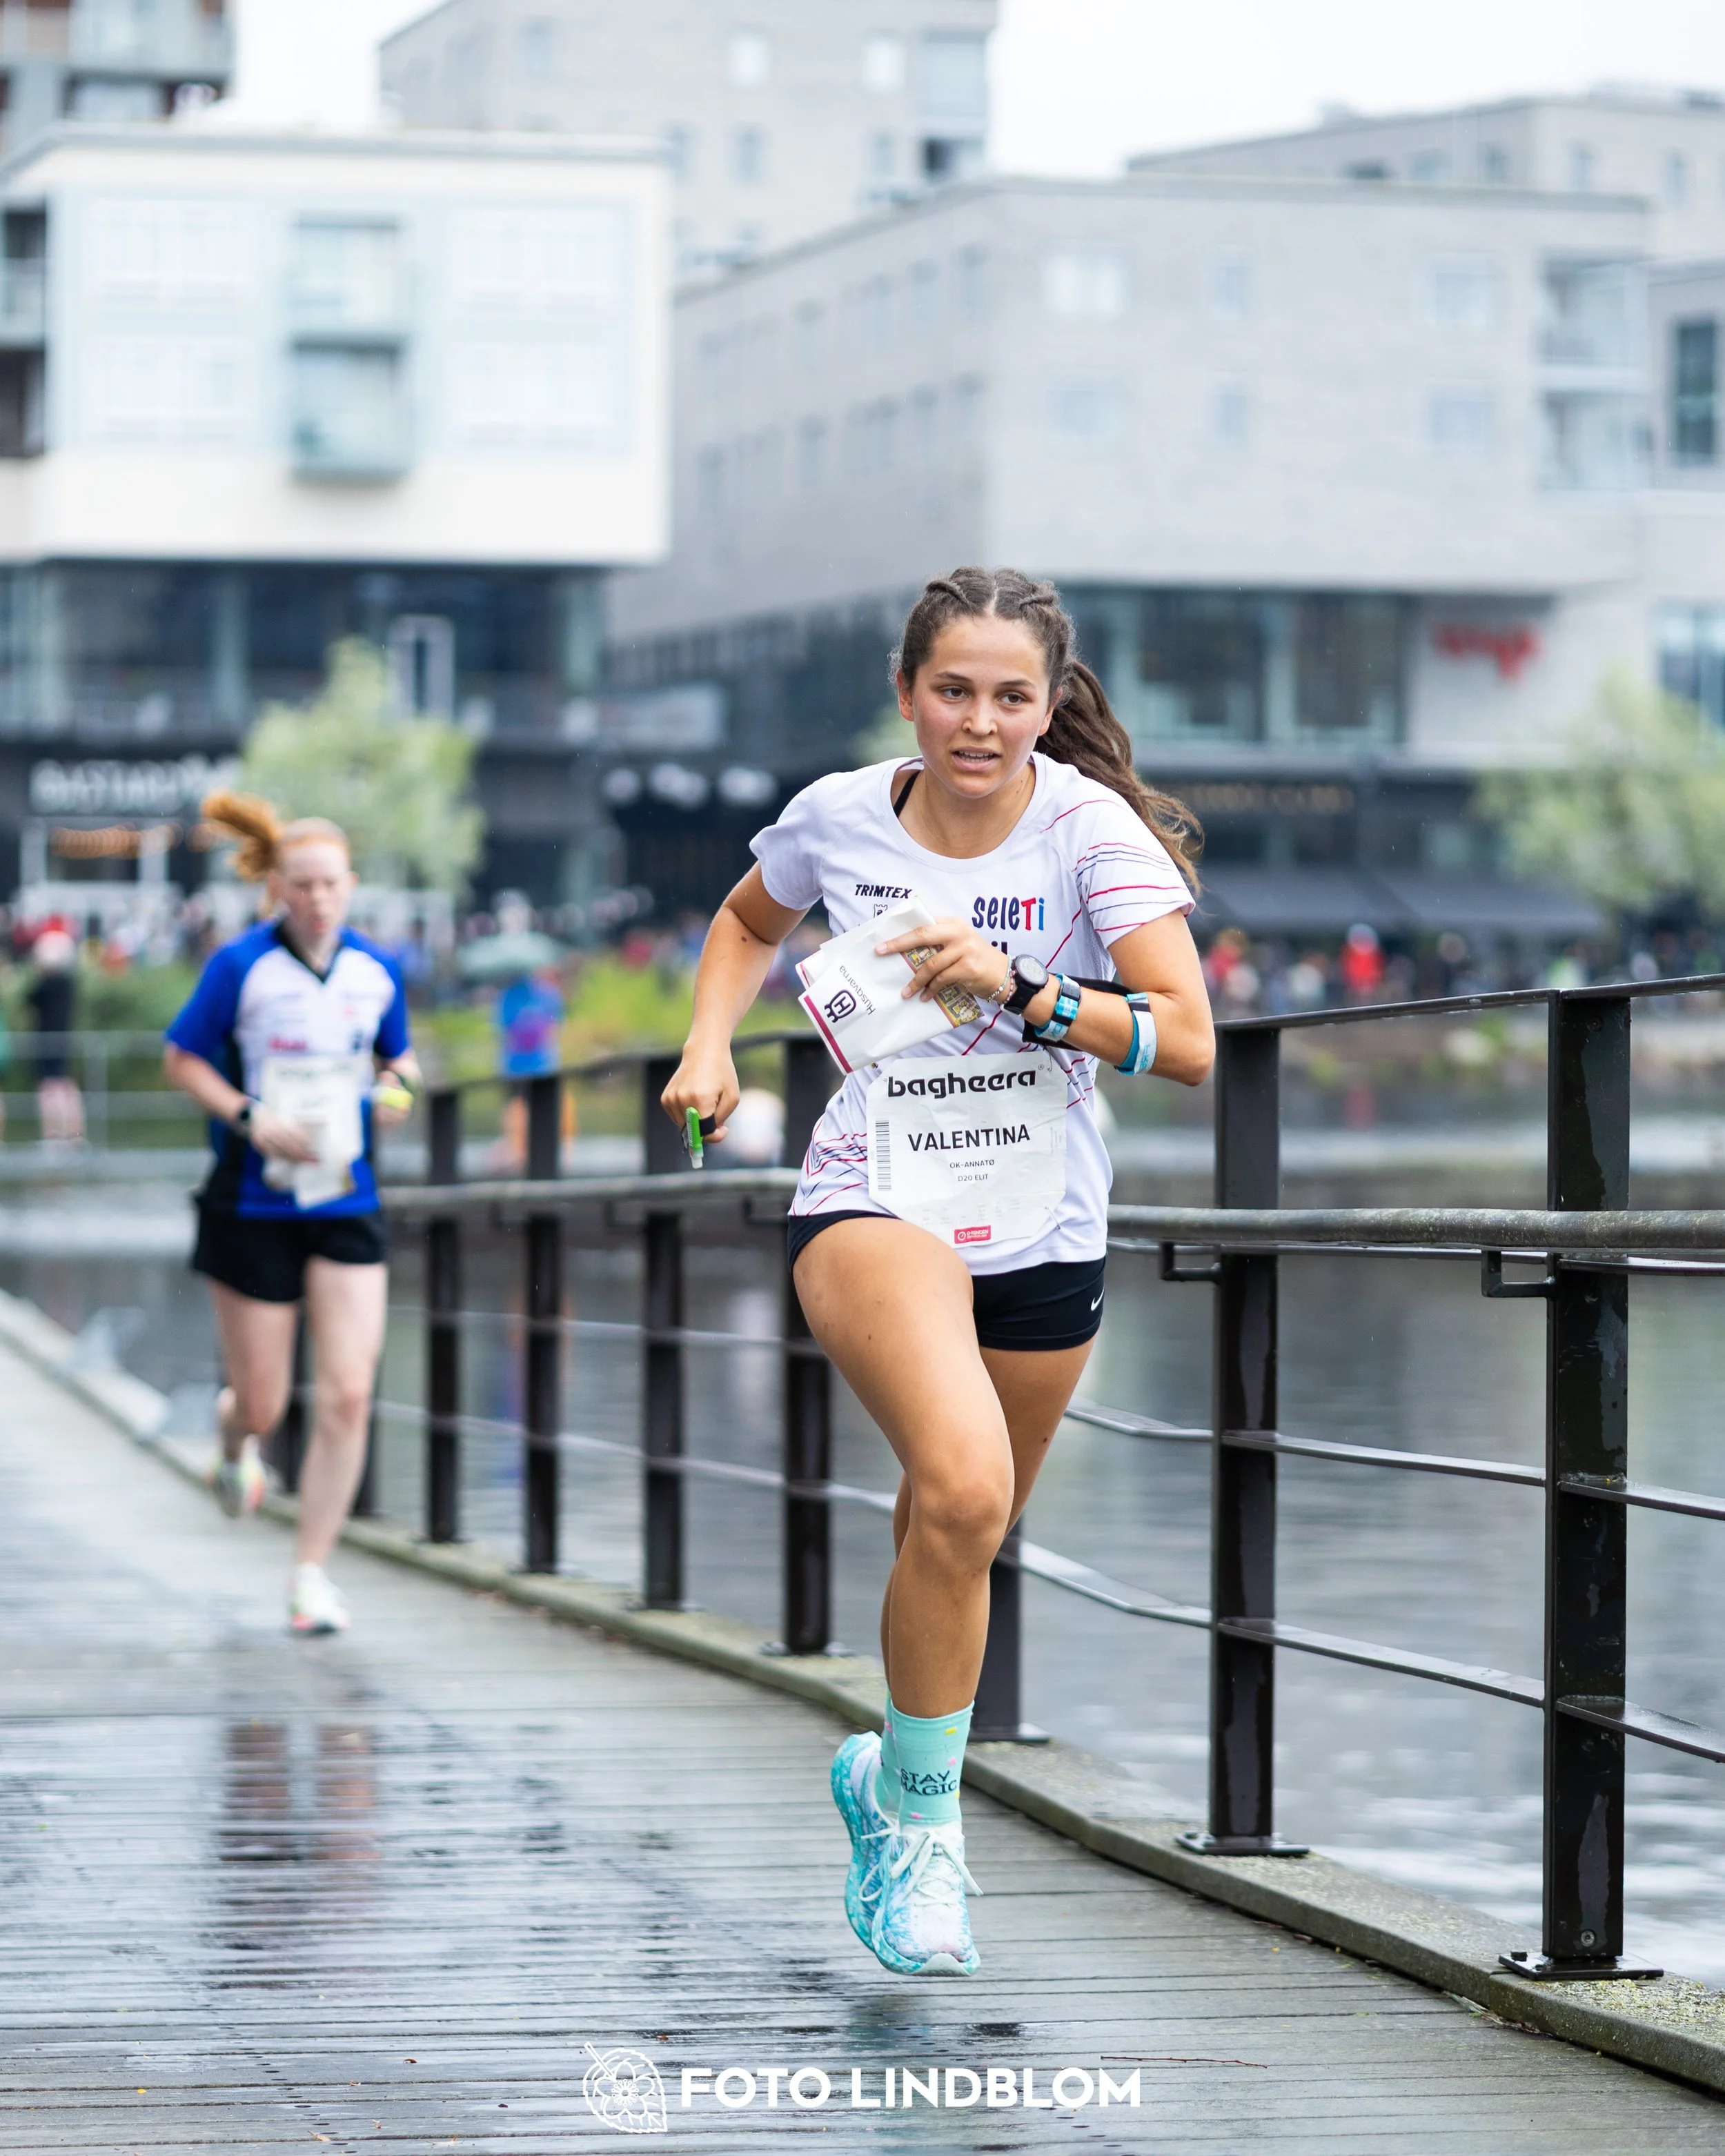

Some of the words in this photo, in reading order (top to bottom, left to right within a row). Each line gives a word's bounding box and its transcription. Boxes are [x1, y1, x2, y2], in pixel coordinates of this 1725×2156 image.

[855, 884, 912, 899] TRIMTEX
[839, 965, 876, 1016] Husqvarna
[888, 1070, 1036, 1099] bagheera
[907, 1124, 1030, 1151] VALENTINA
[949, 1159, 995, 1168] OK-ANNATØ
[900, 1768, 950, 1784] STAY
